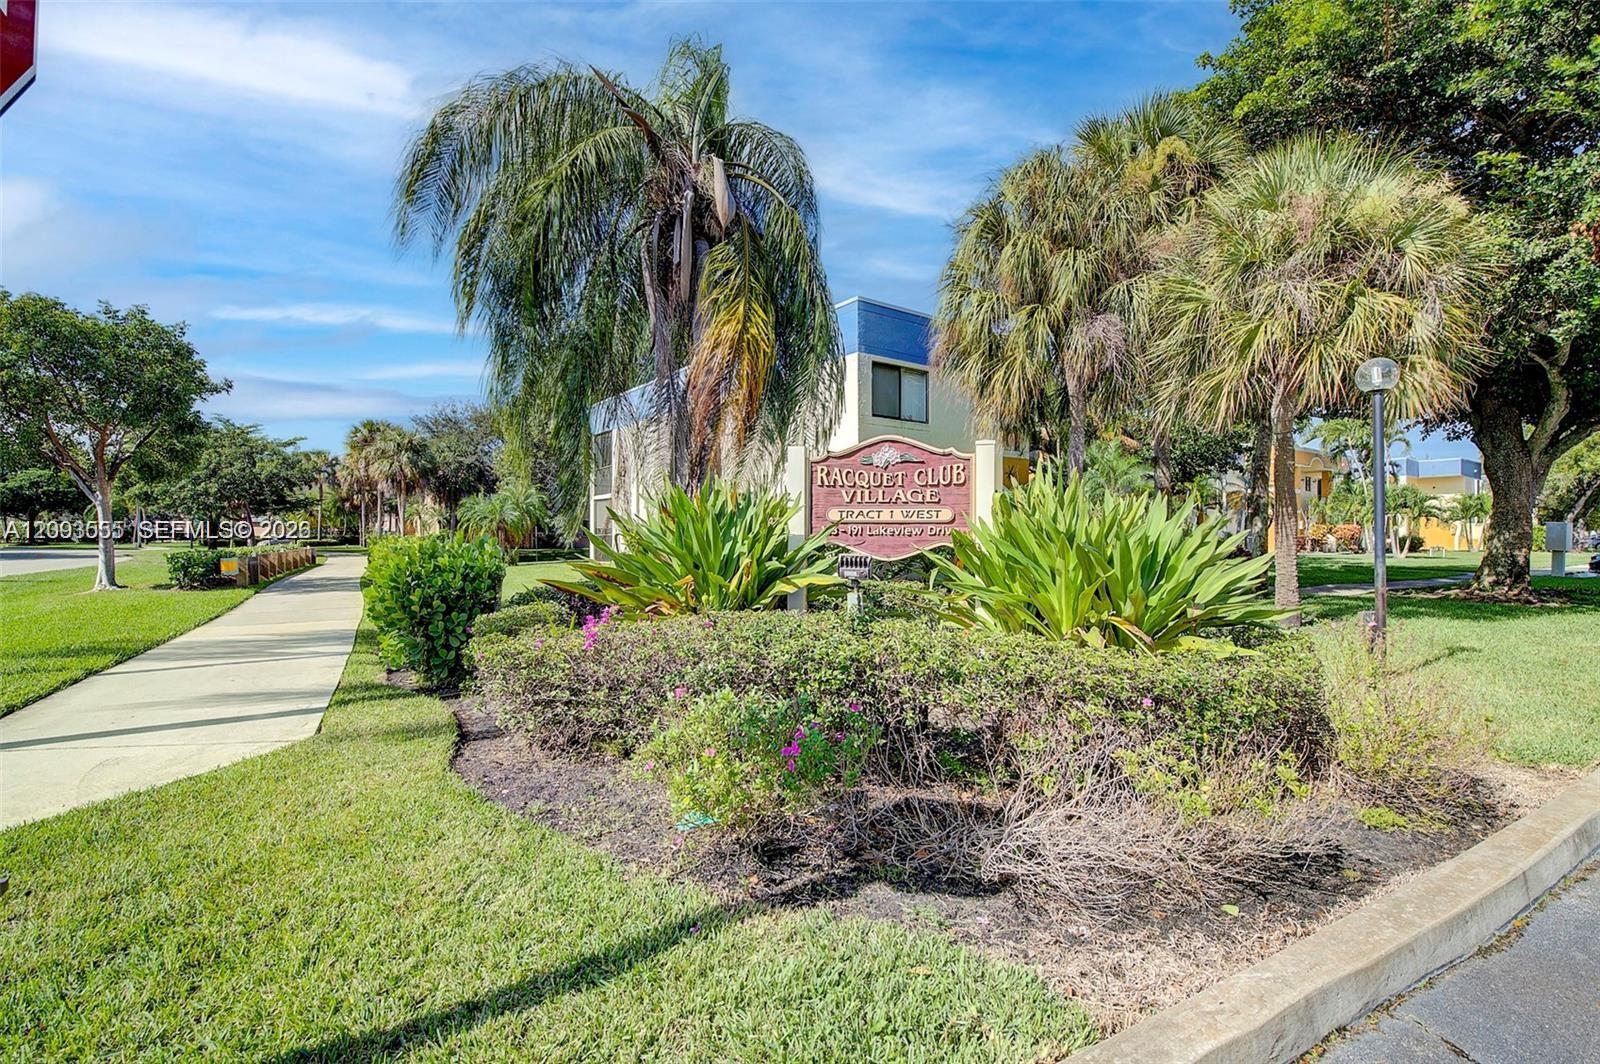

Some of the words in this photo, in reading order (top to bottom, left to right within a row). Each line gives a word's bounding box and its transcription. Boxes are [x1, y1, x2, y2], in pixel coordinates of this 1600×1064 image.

[816, 465, 907, 488] RACQUET
[914, 463, 966, 486] CLUB
[841, 488, 941, 503] VILLAGE
[838, 509, 883, 520] TRACT
[901, 509, 942, 519] WEST
[867, 525, 923, 536] Lakeview
[928, 525, 960, 536] Driv
